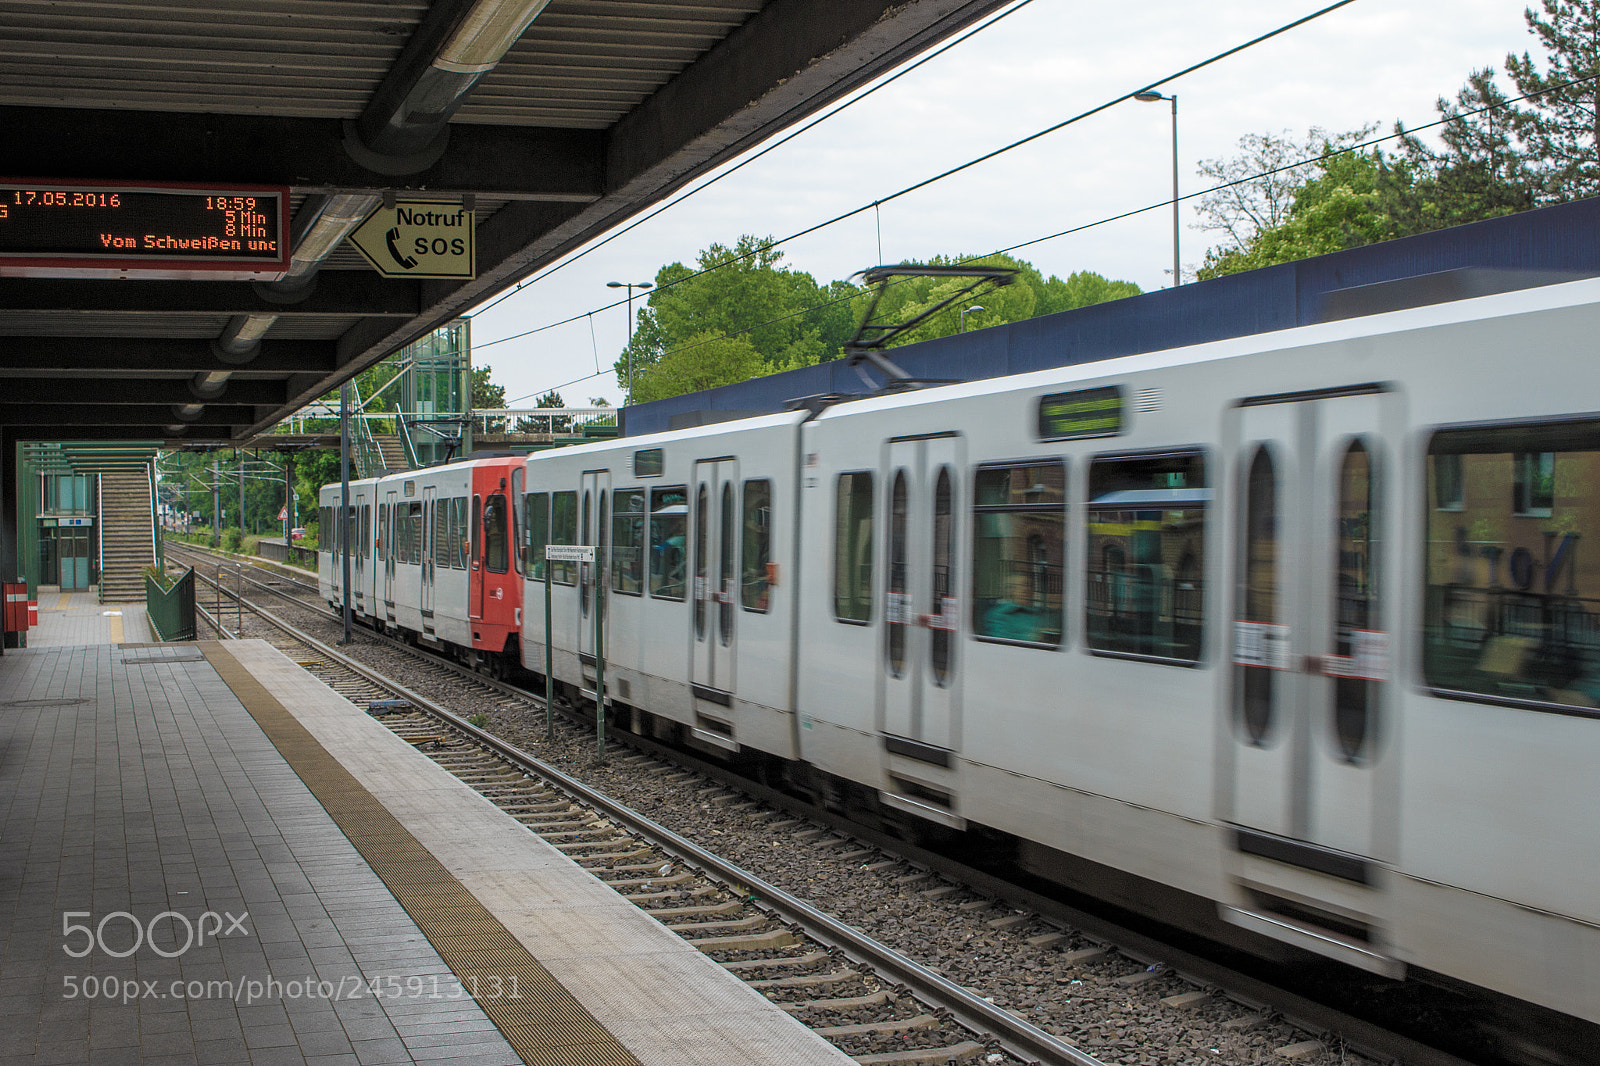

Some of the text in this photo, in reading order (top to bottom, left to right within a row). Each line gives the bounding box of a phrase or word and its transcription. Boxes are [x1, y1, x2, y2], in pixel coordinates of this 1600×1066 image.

[14, 191, 256, 210] 17.05.2016 18:59
[225, 210, 236, 223] 5
[240, 210, 266, 224] Min
[396, 208, 465, 227] Notruf
[225, 223, 266, 237] 8 Min
[100, 233, 137, 248] Vom
[143, 234, 241, 250] Schweißen
[414, 237, 465, 256] SOS
